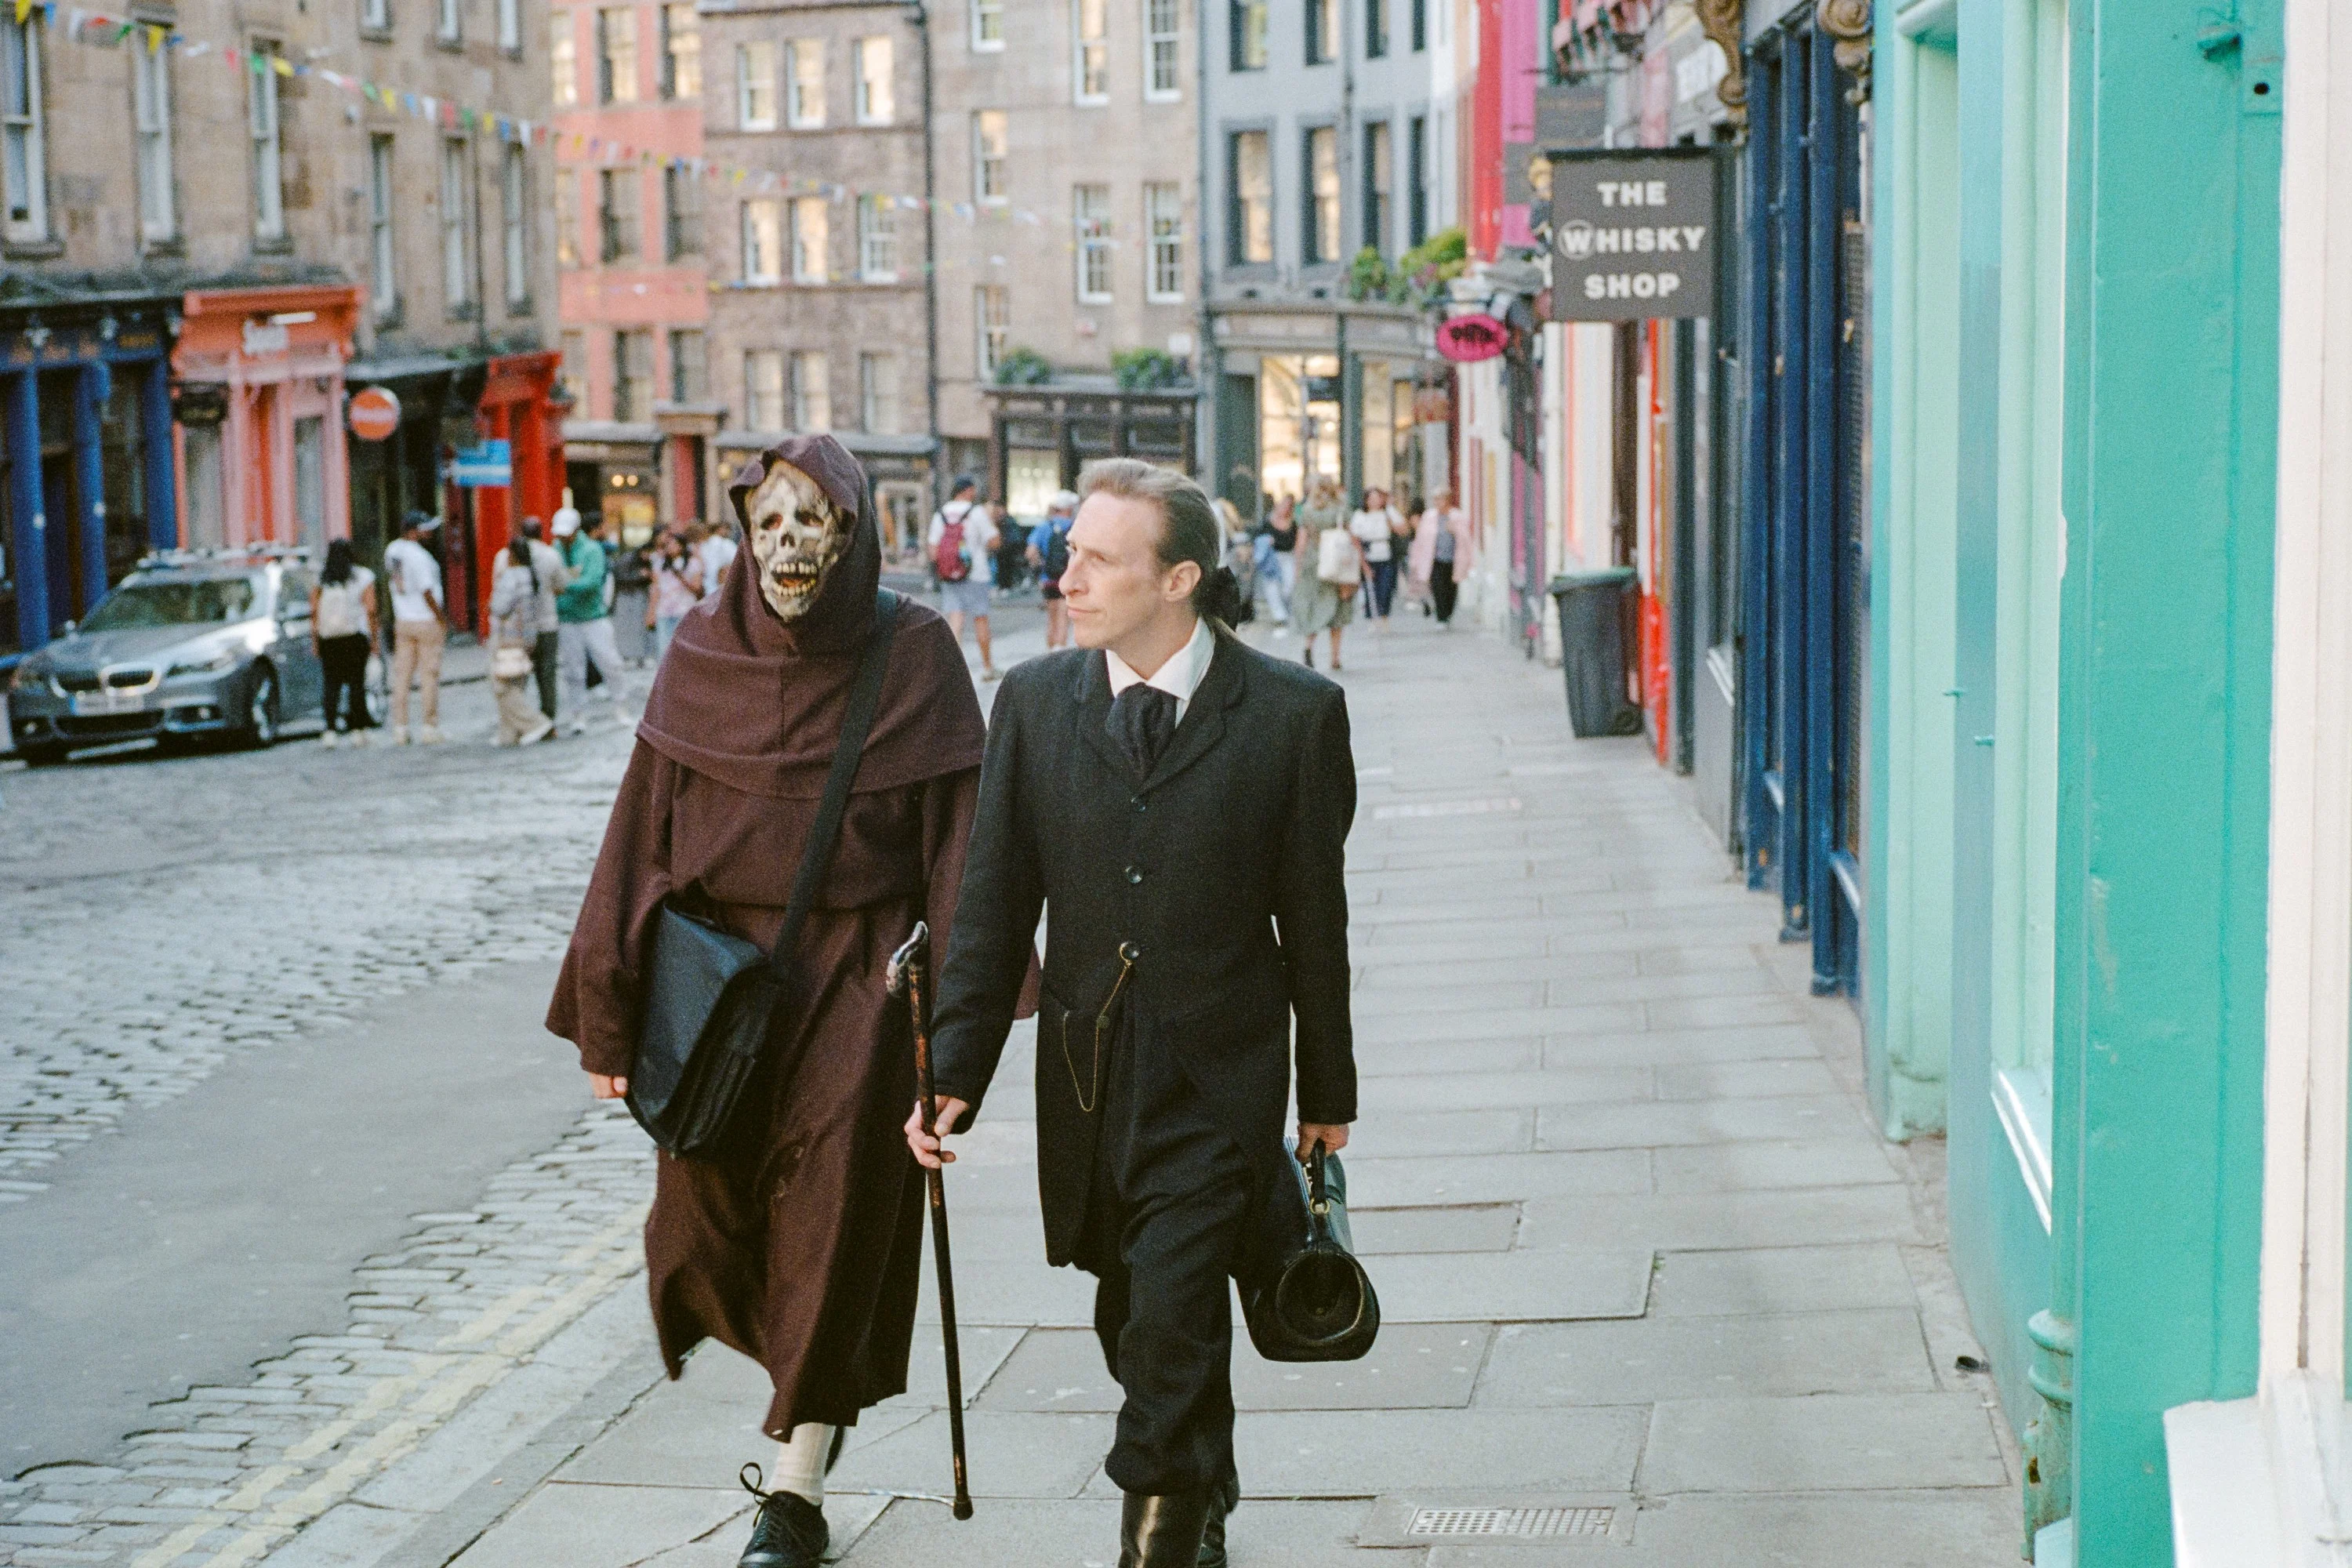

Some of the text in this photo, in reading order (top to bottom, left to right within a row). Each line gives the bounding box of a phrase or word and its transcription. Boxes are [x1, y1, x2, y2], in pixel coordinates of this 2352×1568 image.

[1597, 181, 1667, 206] THE
[1561, 223, 1706, 255] WHISKY
[1584, 273, 1680, 299] SHOP
